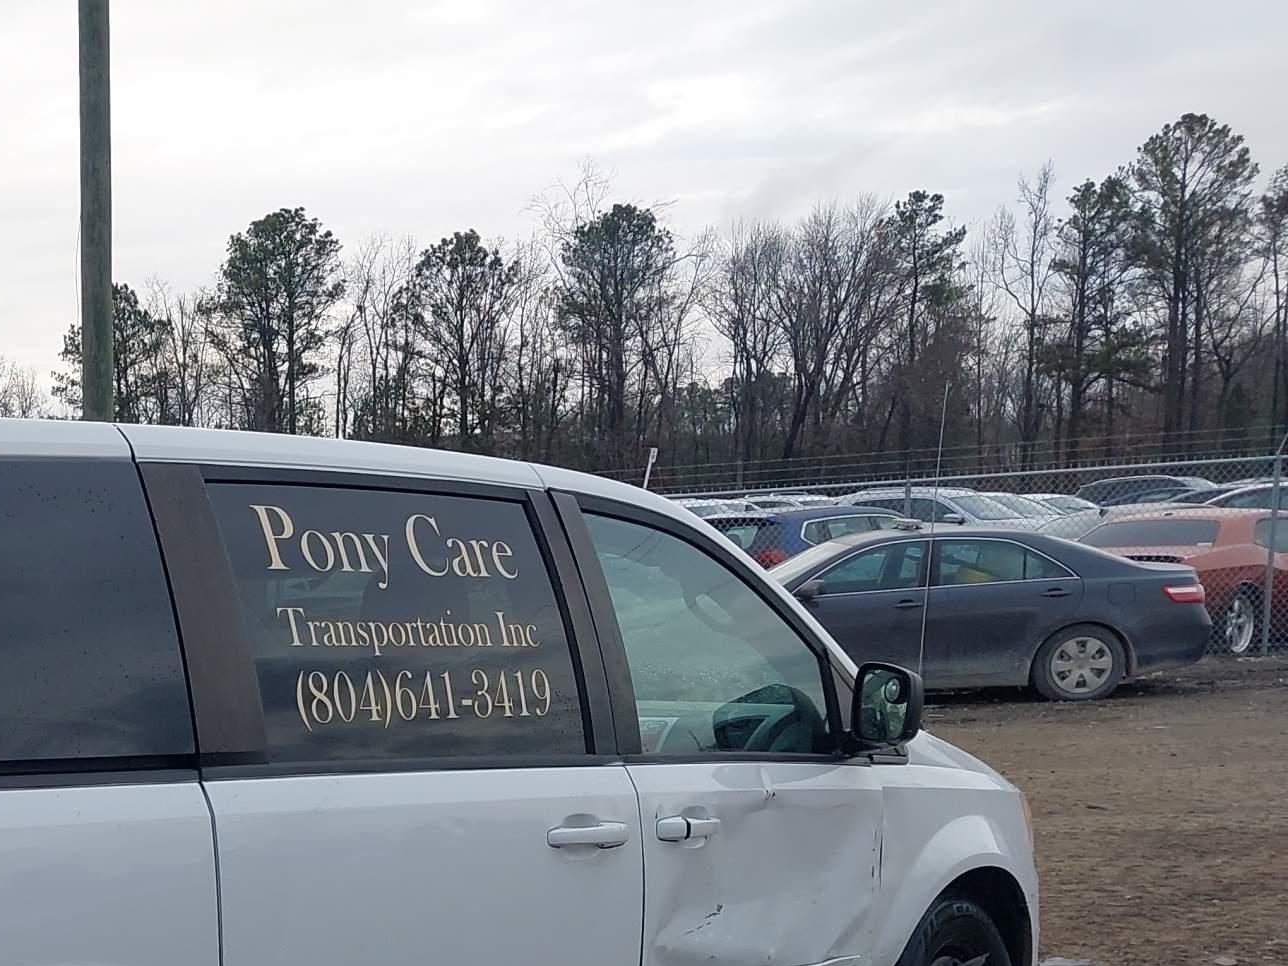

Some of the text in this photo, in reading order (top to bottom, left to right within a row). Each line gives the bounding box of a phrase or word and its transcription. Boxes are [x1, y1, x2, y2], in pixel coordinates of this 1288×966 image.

[249, 505, 519, 589] Pony Care
[277, 607, 540, 656] Transportation Inc
[296, 669, 552, 732] (804)641-3419
